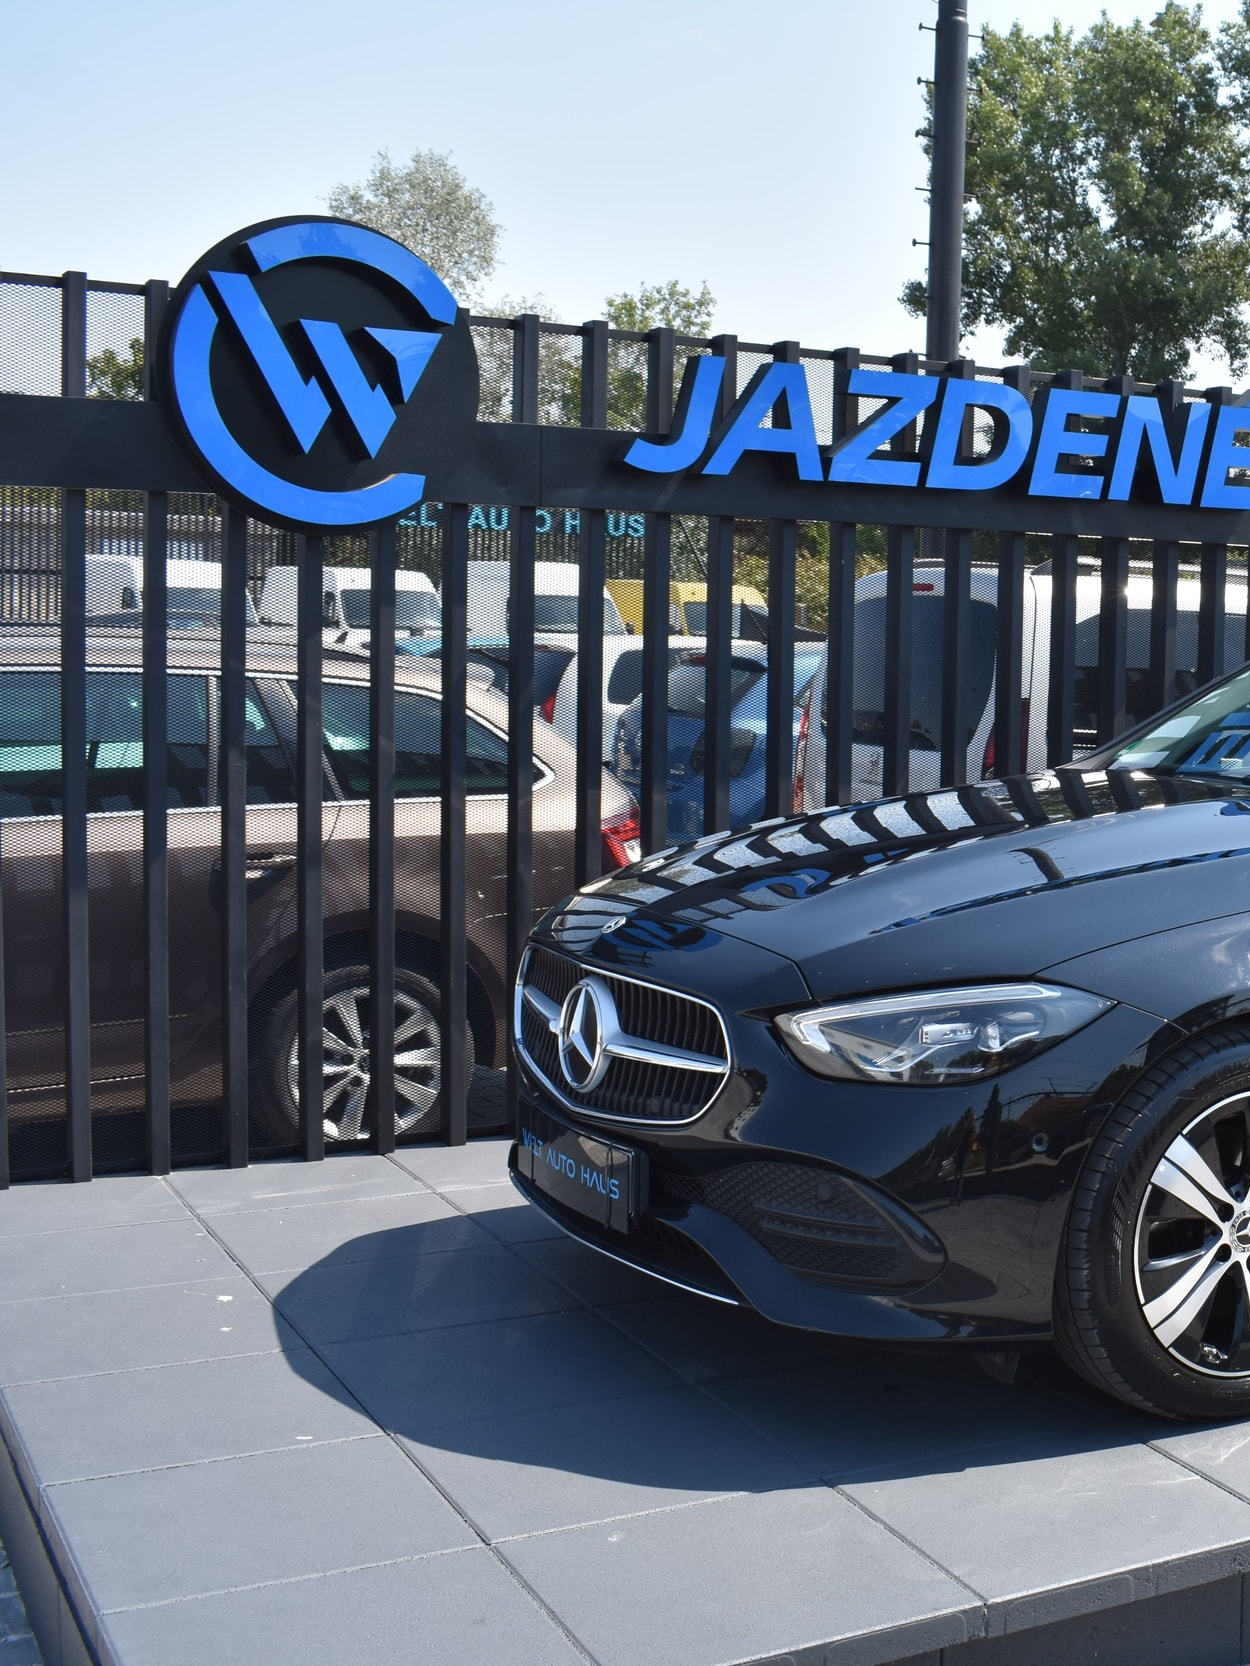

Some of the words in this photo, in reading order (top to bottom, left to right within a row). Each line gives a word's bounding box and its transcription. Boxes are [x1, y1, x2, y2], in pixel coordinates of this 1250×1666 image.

[467, 504, 552, 533] AUO
[564, 509, 646, 538] HUS
[522, 1127, 543, 1158] WELT
[546, 1147, 576, 1178] AUTO
[581, 1164, 620, 1200] HAUS
